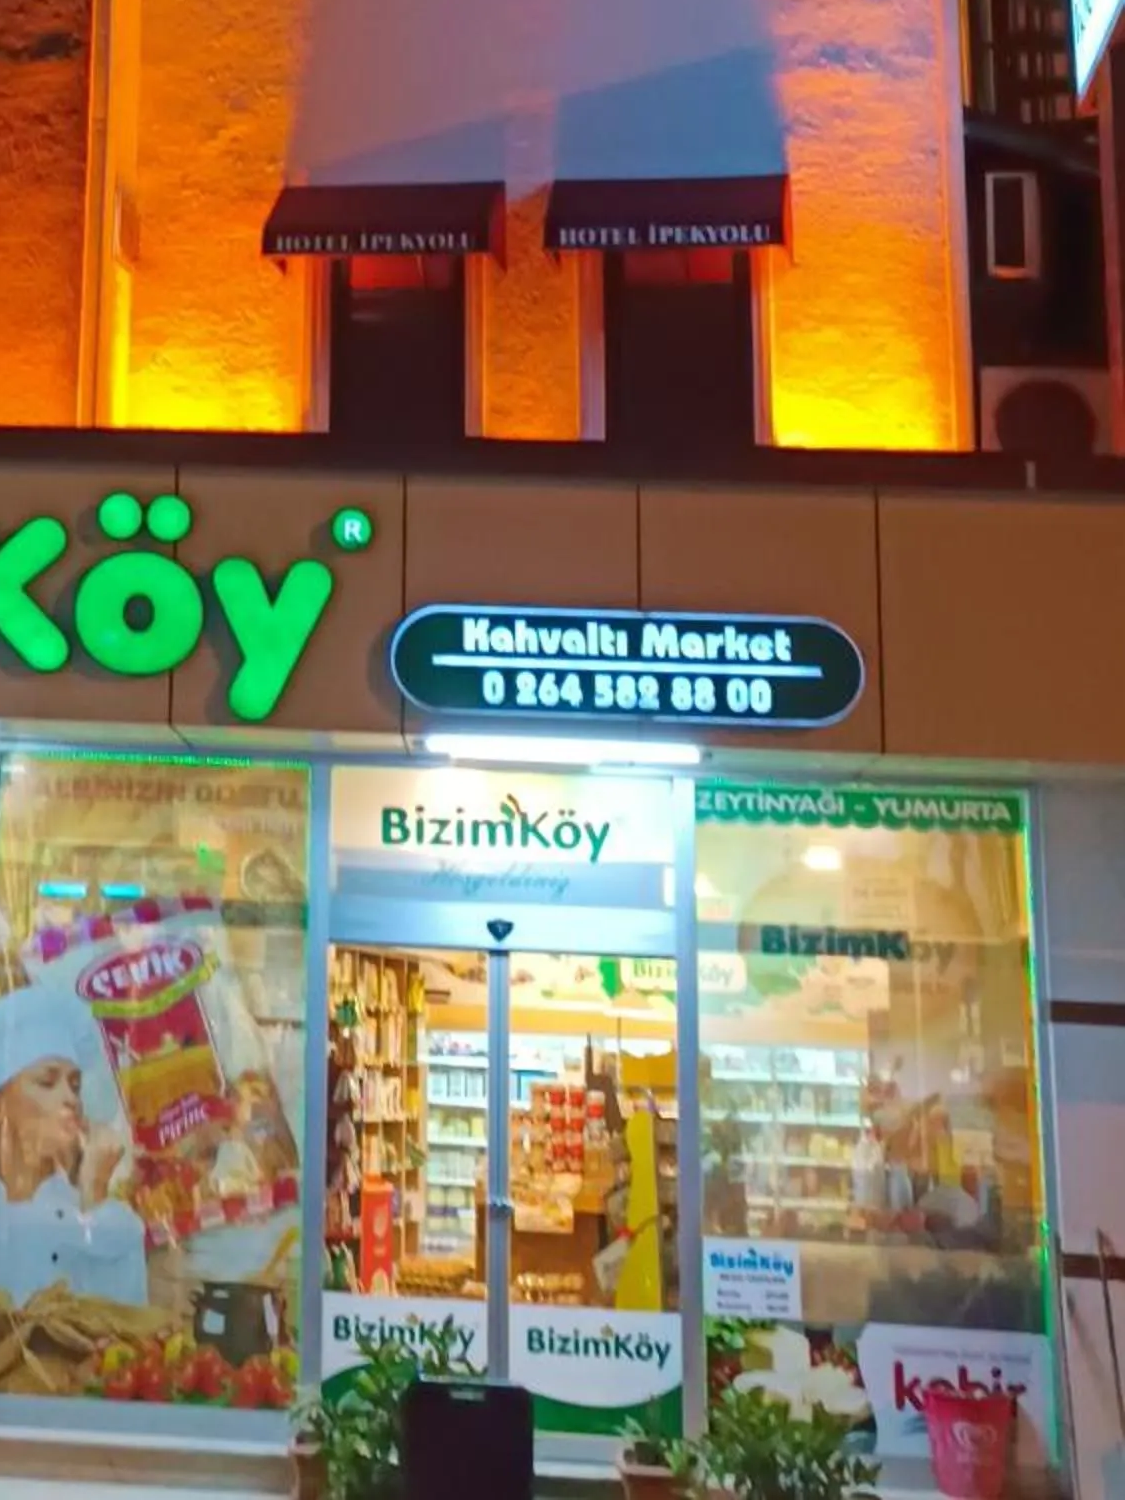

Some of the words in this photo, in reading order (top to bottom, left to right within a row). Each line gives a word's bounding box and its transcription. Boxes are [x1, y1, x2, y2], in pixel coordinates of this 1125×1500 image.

[560, 226, 642, 247] HOTEL
[462, 617, 628, 658] Kahvaltı
[640, 621, 793, 663] Market
[482, 670, 506, 706] 0
[516, 671, 584, 708] 264
[594, 673, 660, 711] 582
[671, 675, 716, 713] 88
[726, 677, 773, 715] 00
[696, 785, 845, 815] ZEYTİNYAĞI
[873, 795, 1013, 823] YUMURTA
[381, 803, 611, 863] BizimKöy
[527, 1325, 672, 1371] BizimKöy
